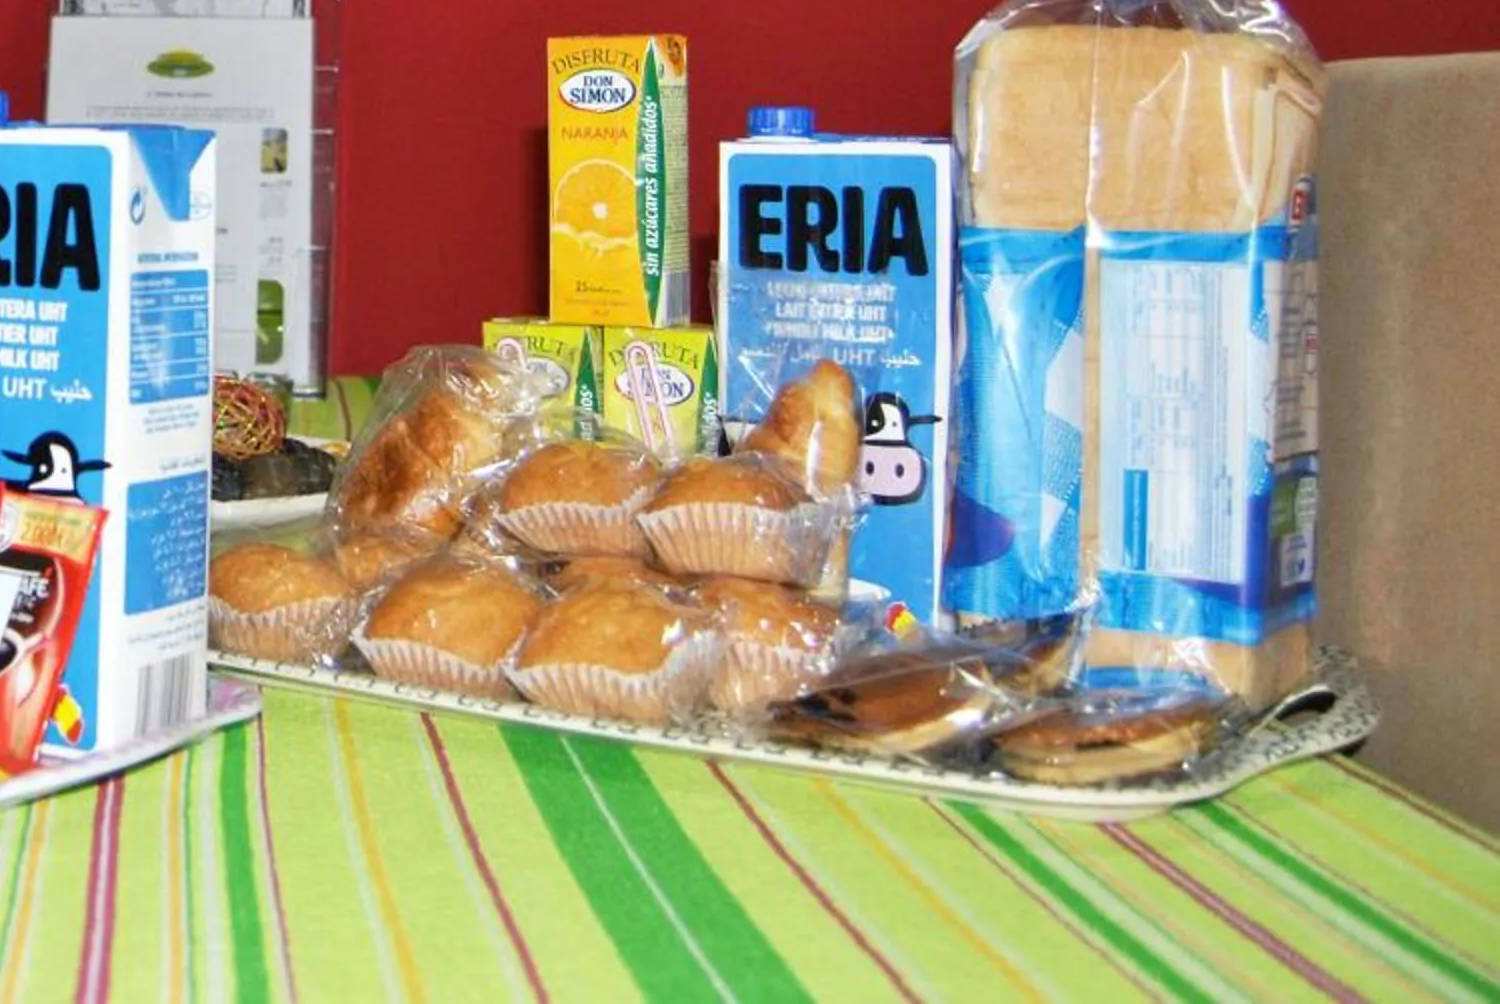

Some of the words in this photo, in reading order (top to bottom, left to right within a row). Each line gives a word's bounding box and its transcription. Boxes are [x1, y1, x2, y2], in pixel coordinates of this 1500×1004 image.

[552, 48, 640, 74] DISFRUTA
[583, 75, 614, 87] DON
[569, 87, 627, 104] SIMON
[738, 184, 929, 277] ERIA
[39, 301, 68, 322] UHT
[29, 325, 59, 346] UHT
[30, 349, 60, 372] UHT
[2, 375, 48, 400] UHT
